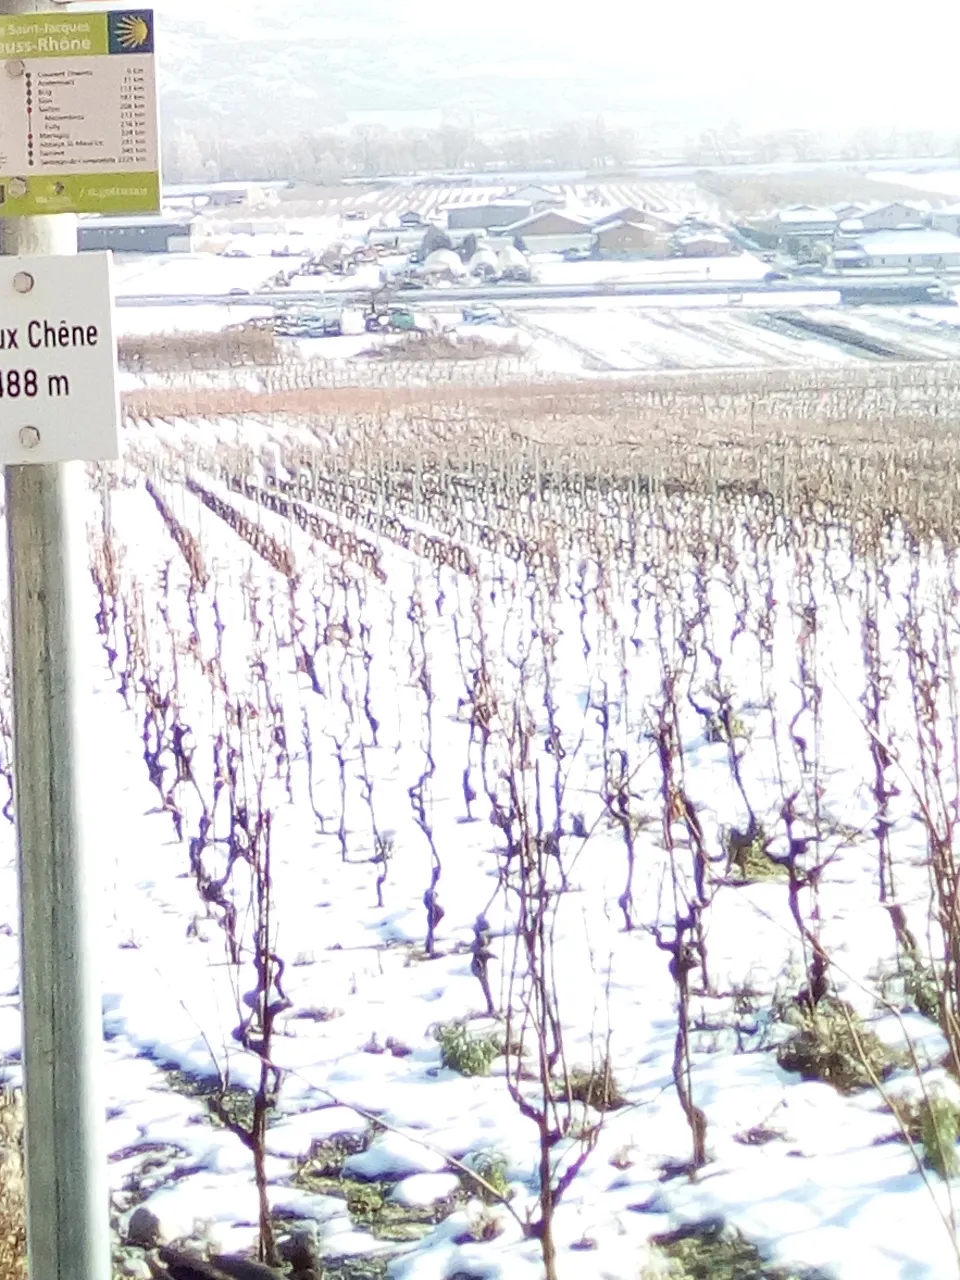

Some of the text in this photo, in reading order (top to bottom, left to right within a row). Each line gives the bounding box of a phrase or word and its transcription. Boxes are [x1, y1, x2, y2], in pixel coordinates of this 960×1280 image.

[8, 22, 90, 36] Saint-Jacques
[28, 319, 98, 348] Chêne
[48, 375, 70, 396] m
